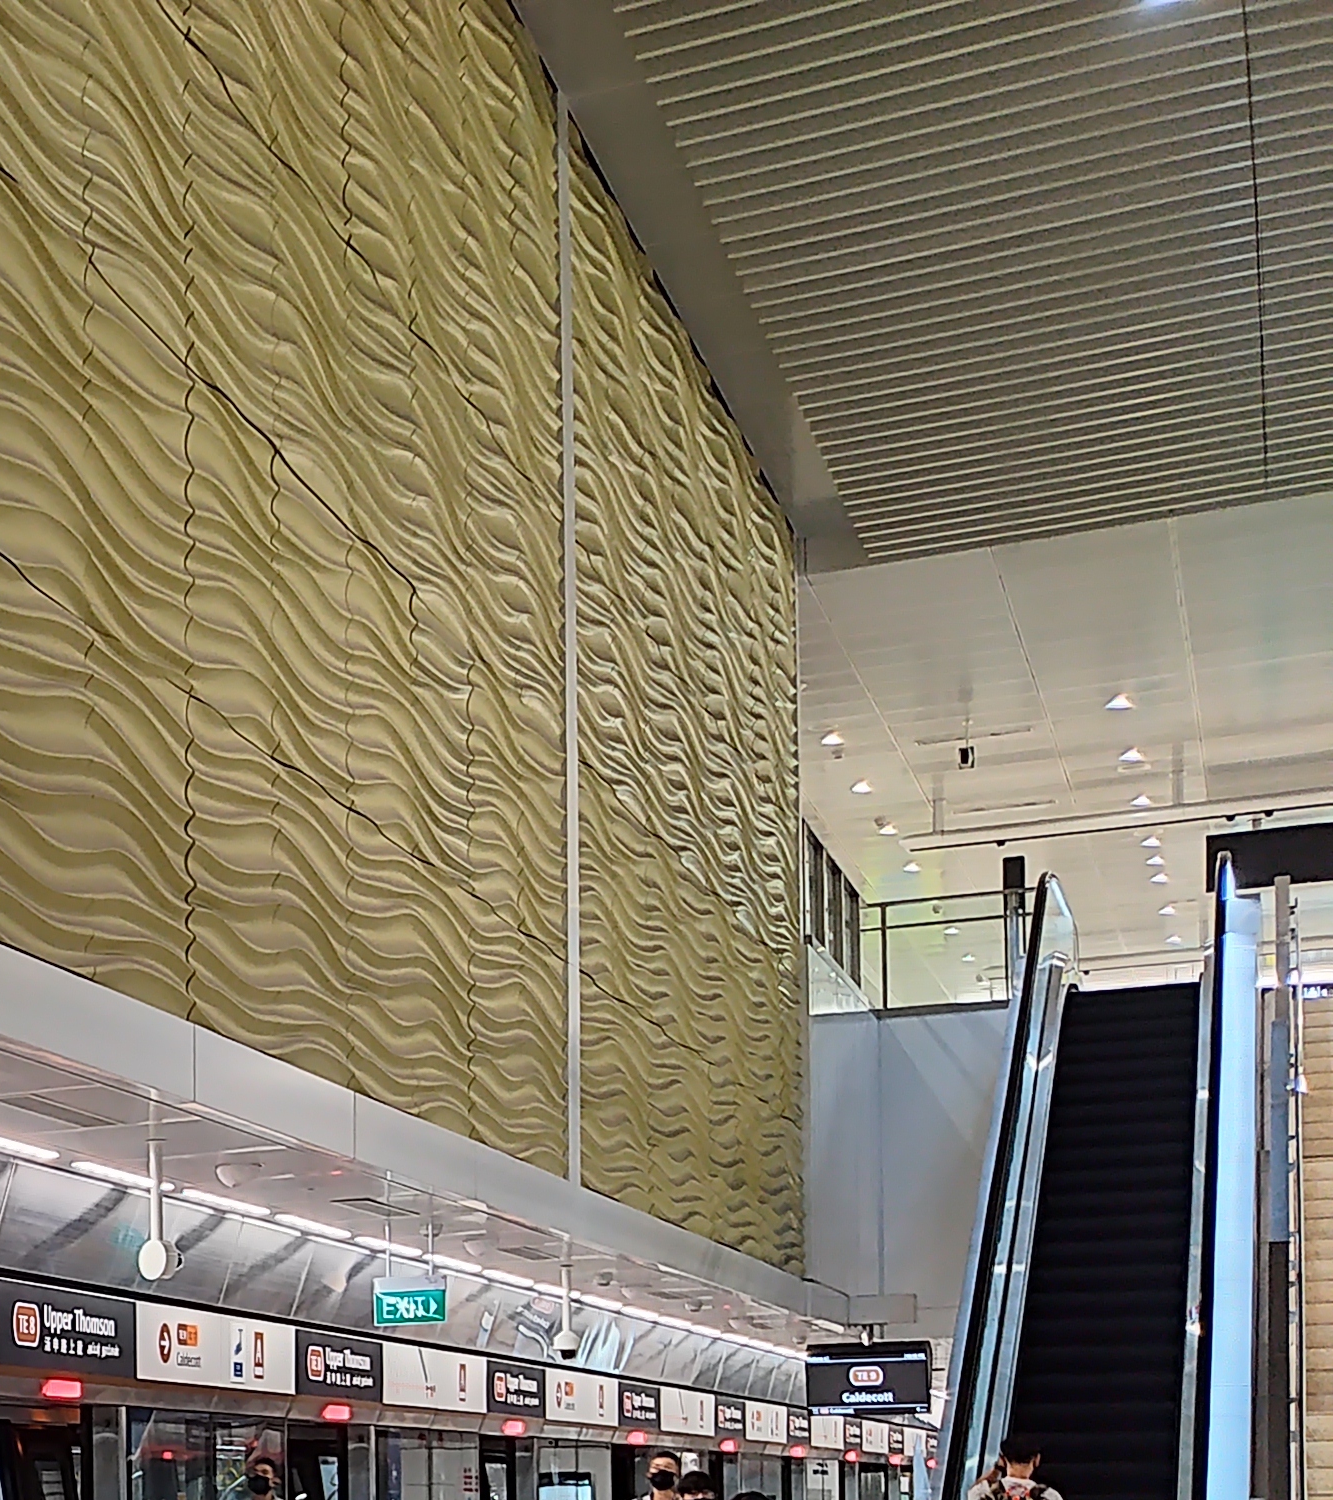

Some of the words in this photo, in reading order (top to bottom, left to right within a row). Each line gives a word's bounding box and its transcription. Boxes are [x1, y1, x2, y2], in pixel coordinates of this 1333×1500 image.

[382, 1296, 426, 1319] EXIT
[18, 1314, 29, 1333] TE
[29, 1315, 36, 1335] 8
[43, 1303, 73, 1334] Upper
[74, 1308, 115, 1337] Thomson
